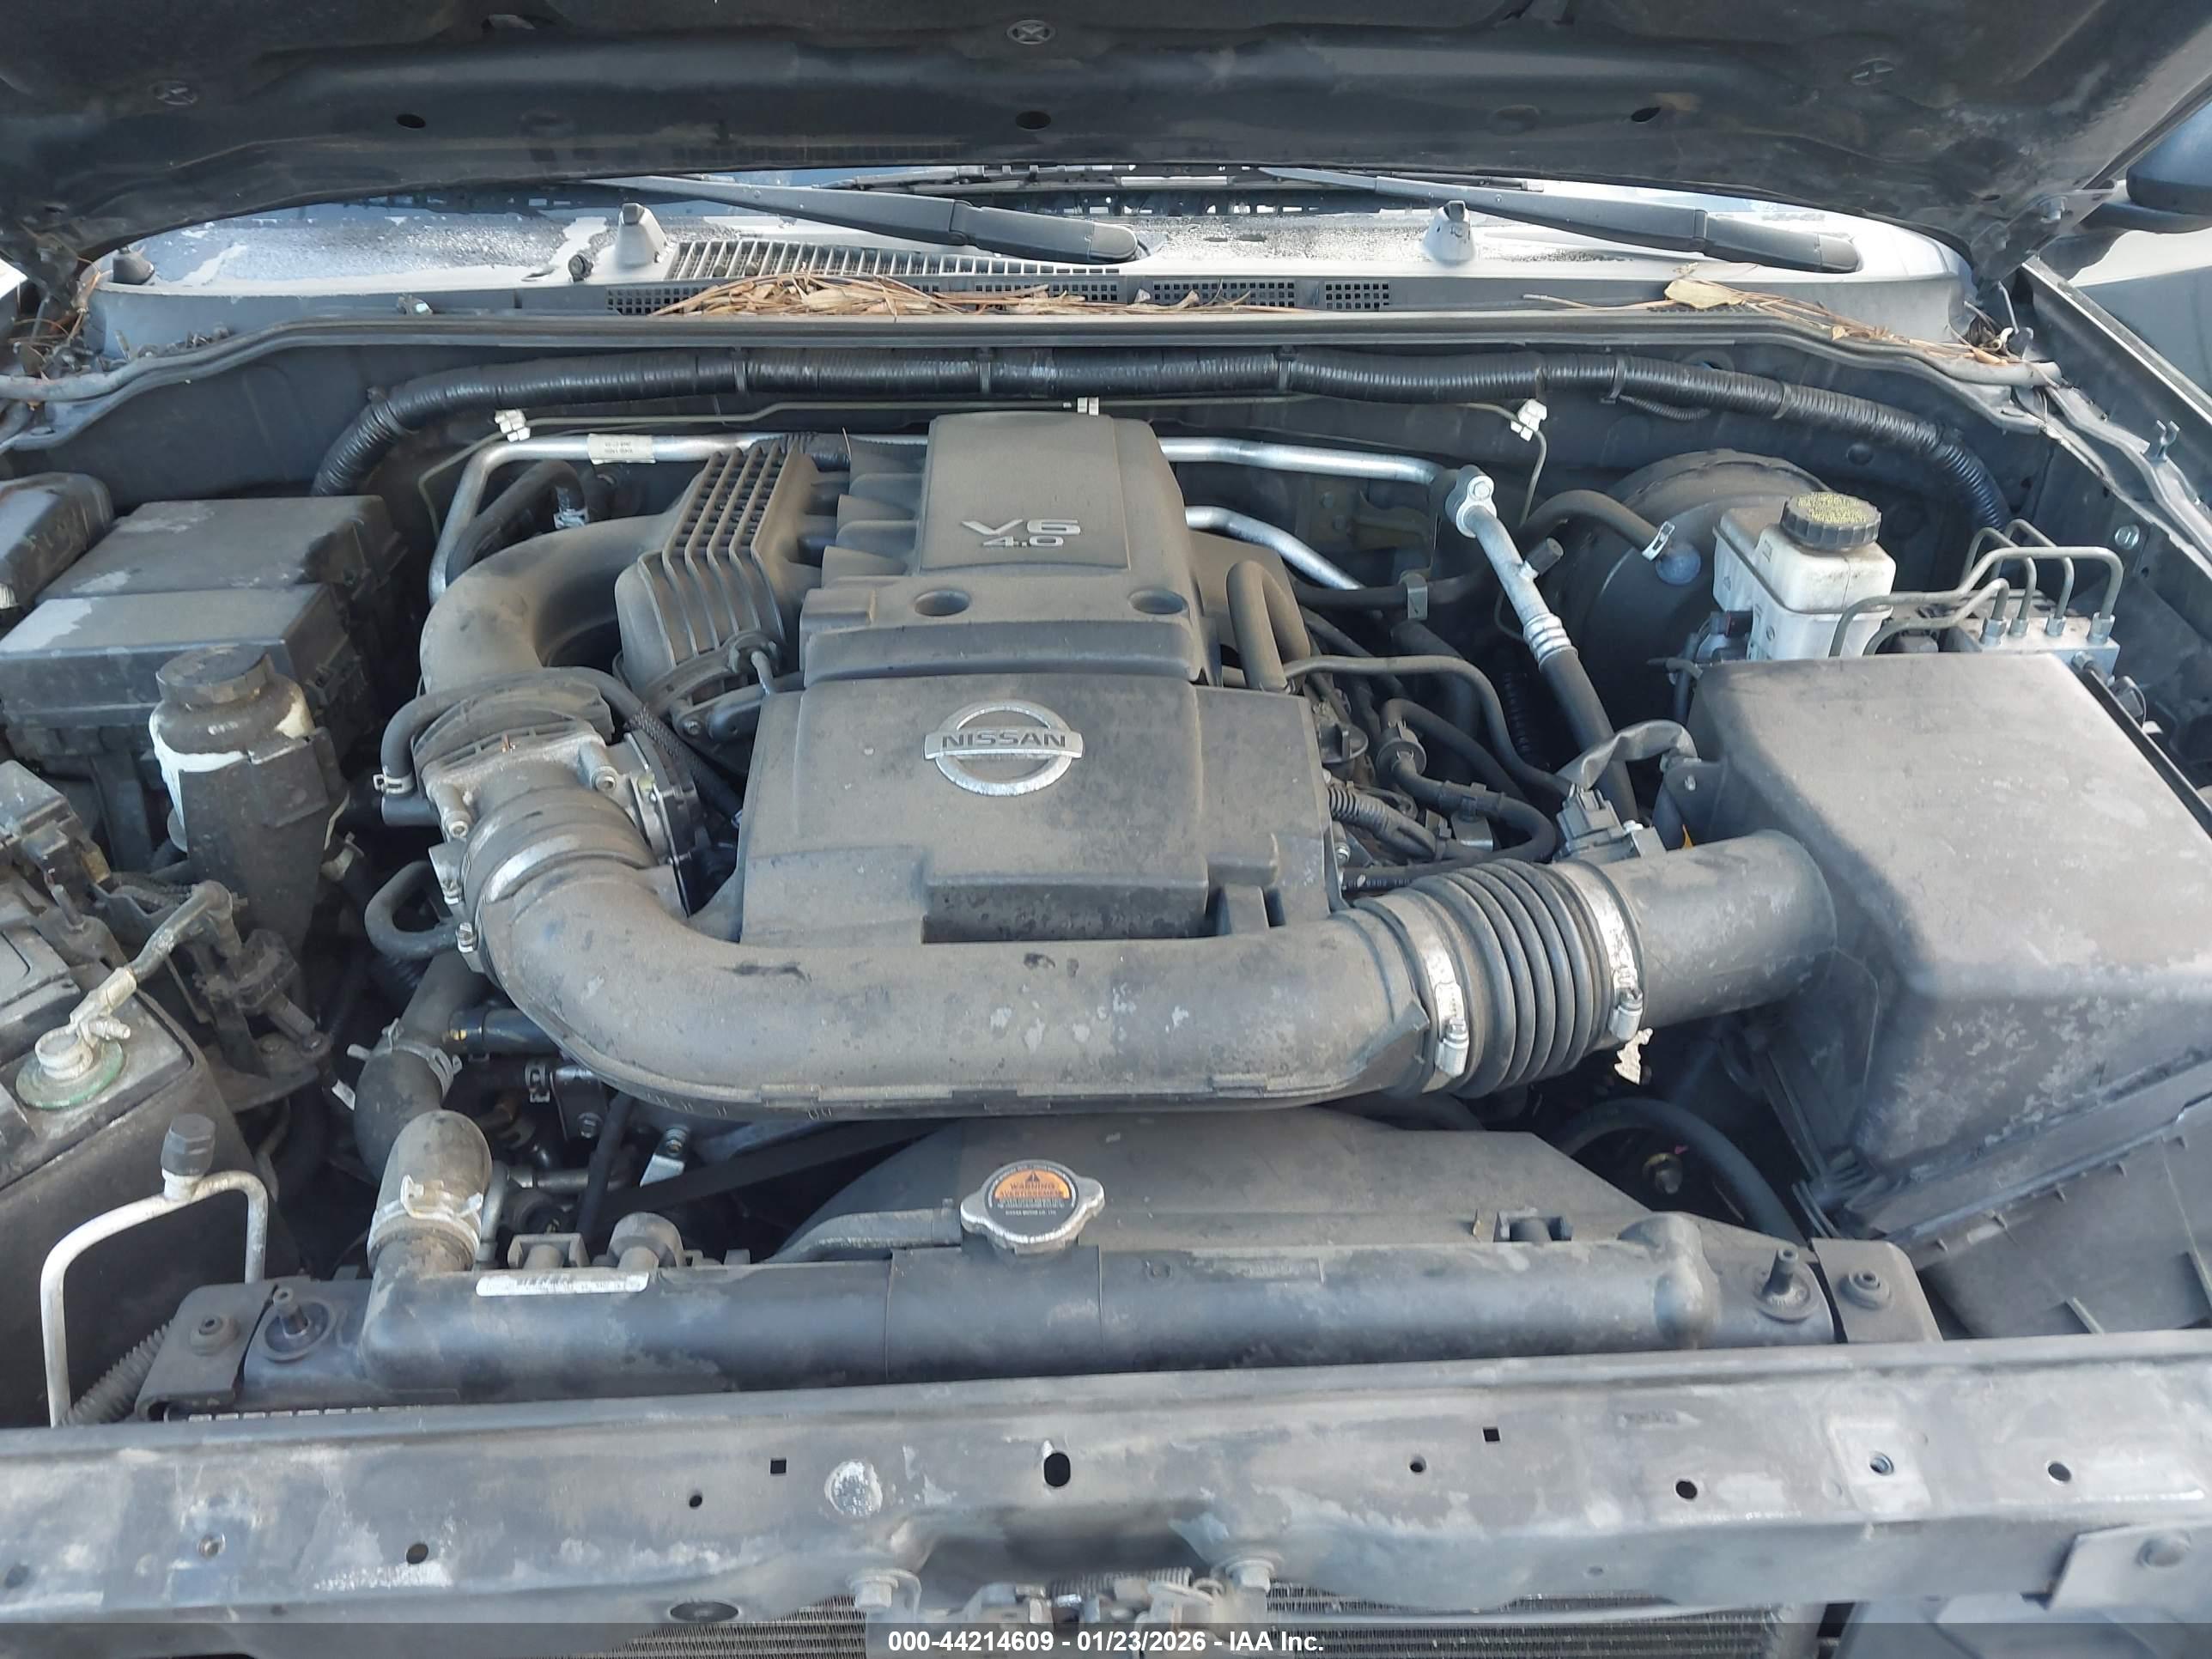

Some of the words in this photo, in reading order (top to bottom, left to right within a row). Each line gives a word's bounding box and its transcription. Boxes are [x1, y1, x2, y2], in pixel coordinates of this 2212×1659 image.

[961, 519, 1081, 536] V6
[981, 536, 1064, 547] 4.0
[942, 732, 1066, 748] NISSAN
[1010, 1182, 1056, 1190] WARNING
